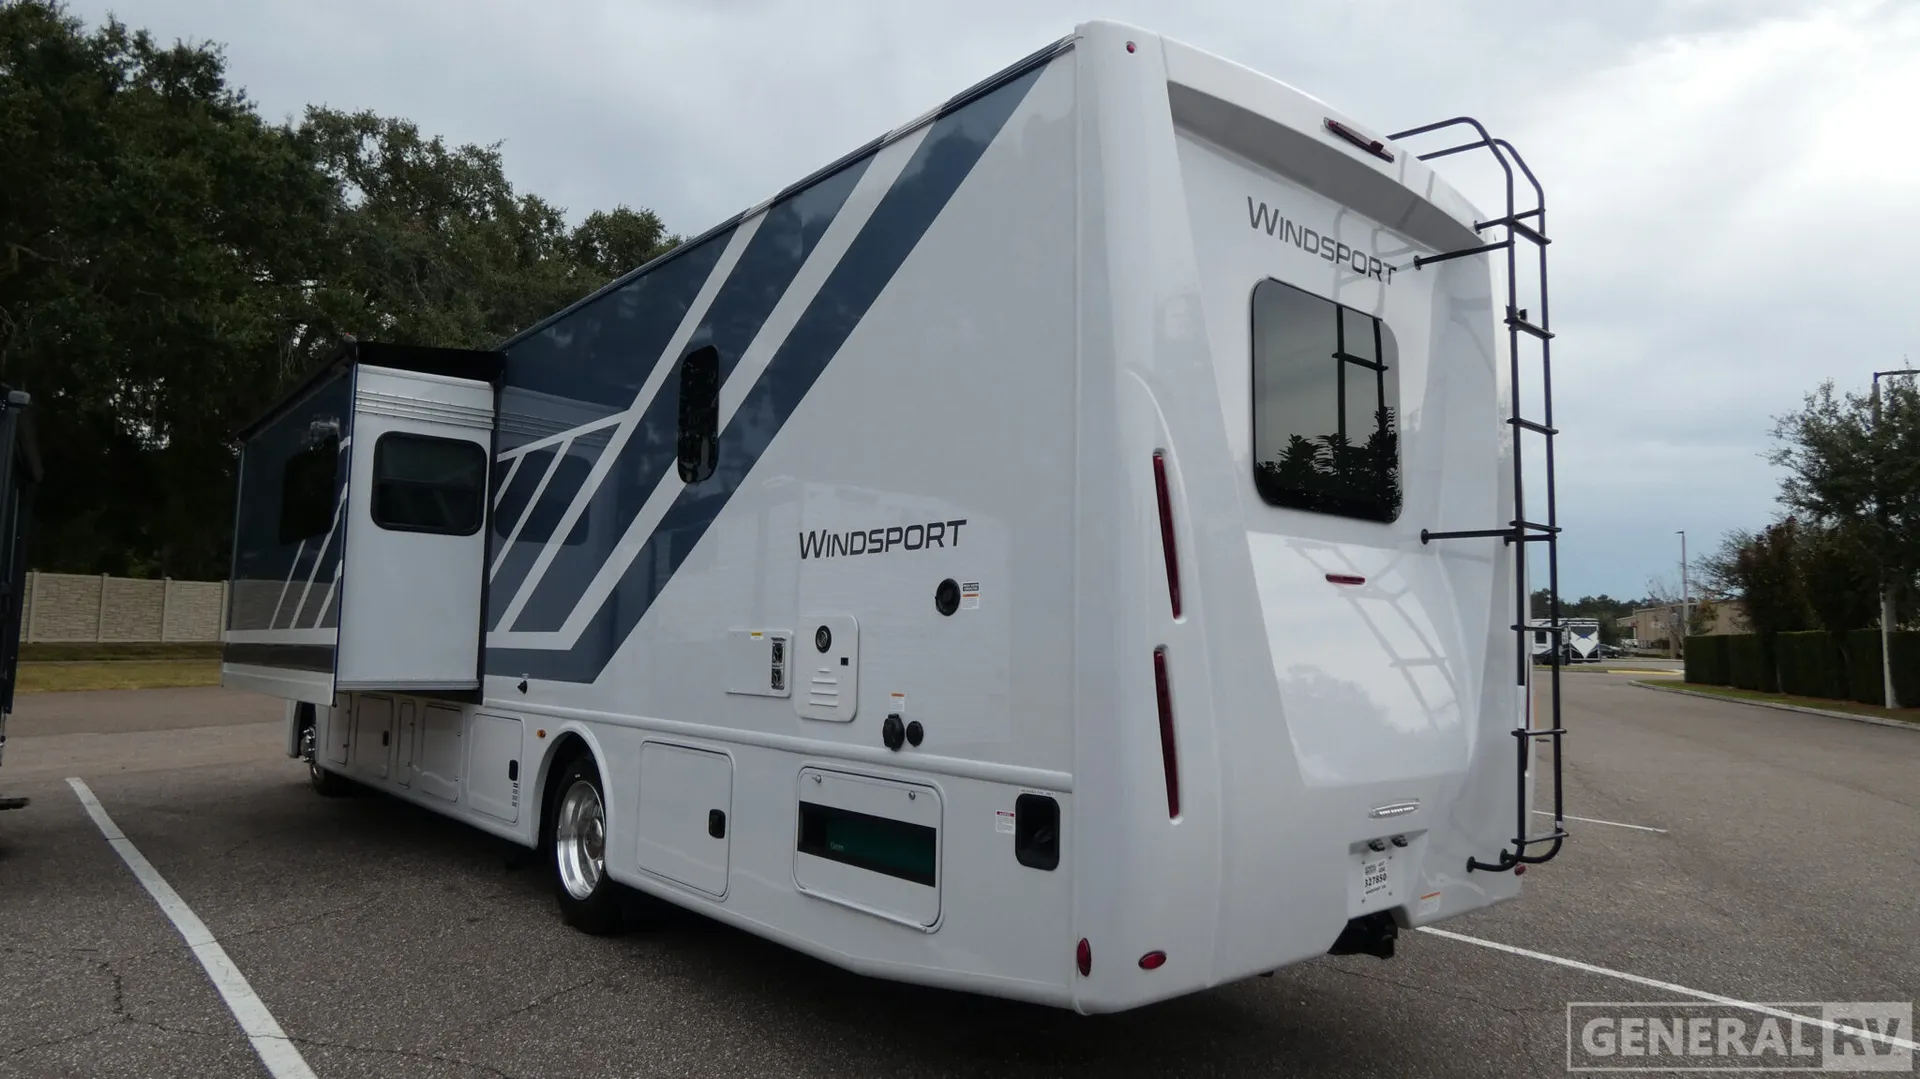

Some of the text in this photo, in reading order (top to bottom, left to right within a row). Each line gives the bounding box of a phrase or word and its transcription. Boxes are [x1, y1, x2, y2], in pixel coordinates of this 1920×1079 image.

[1247, 196, 1397, 285] WINDSPORT
[799, 519, 967, 560] WINDSPORT
[1364, 873, 1387, 888] 327850
